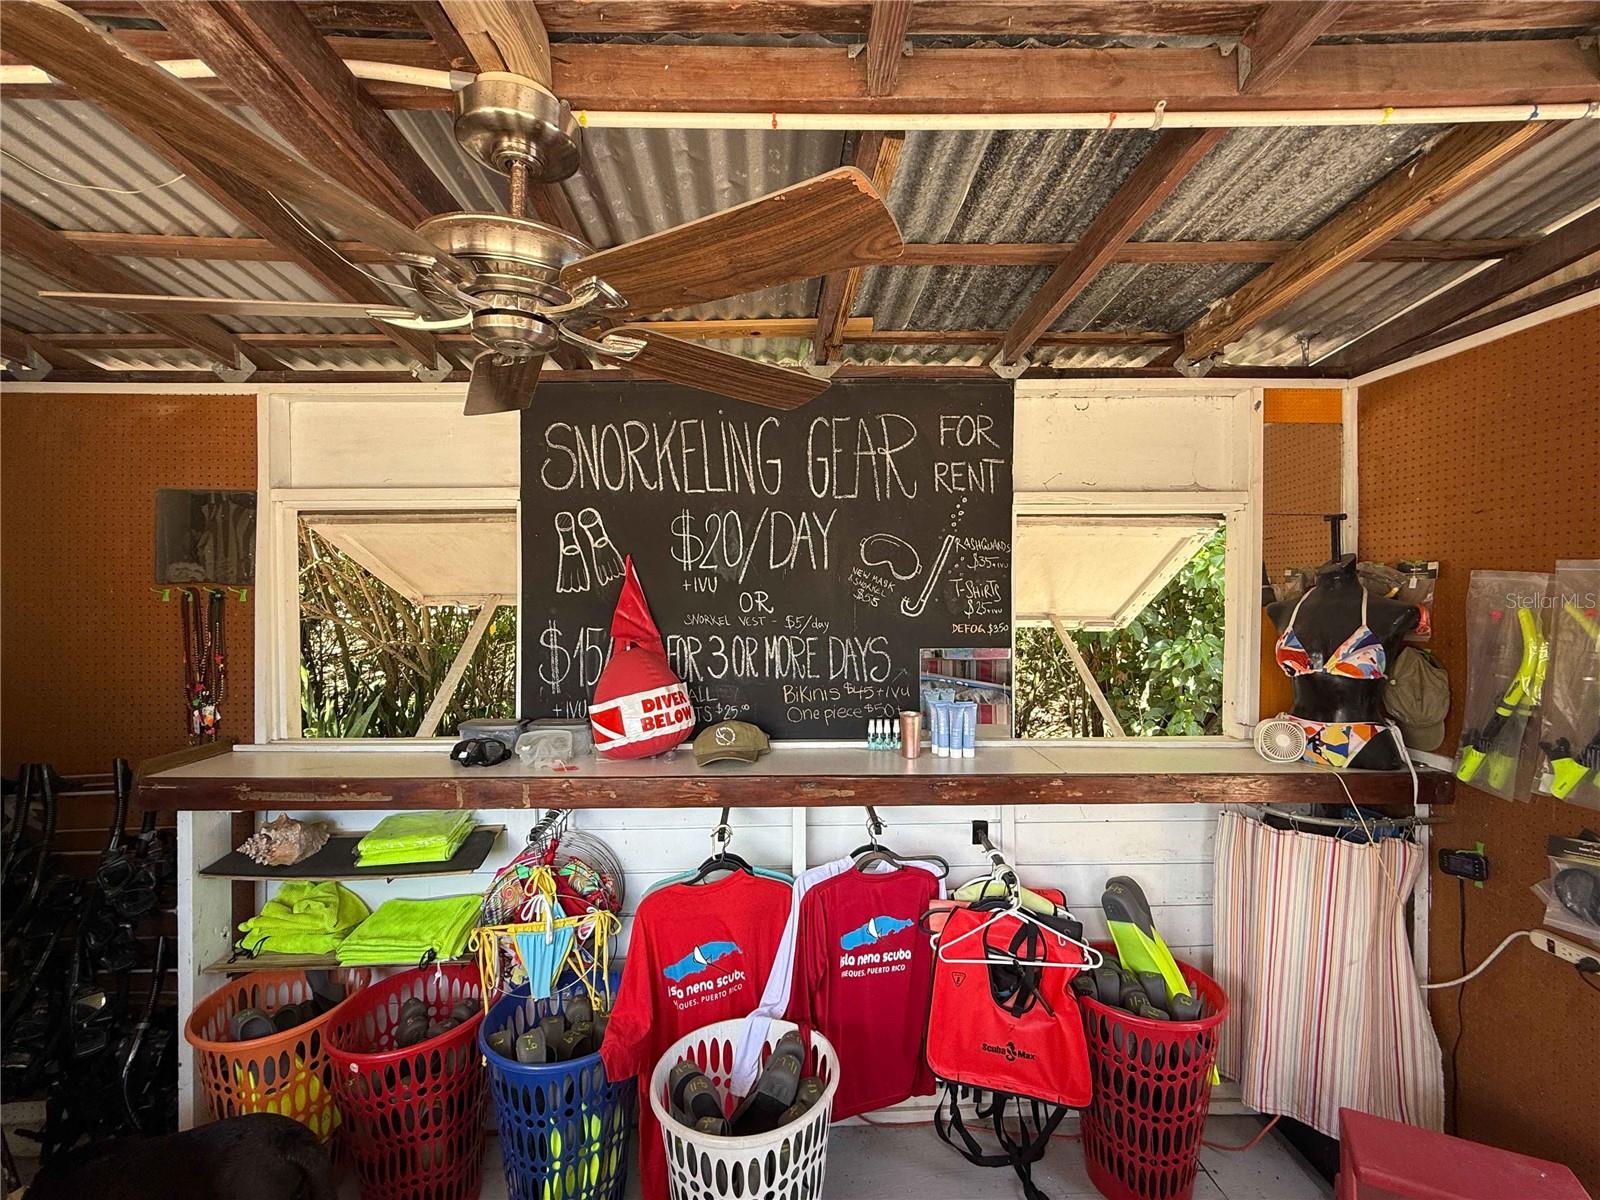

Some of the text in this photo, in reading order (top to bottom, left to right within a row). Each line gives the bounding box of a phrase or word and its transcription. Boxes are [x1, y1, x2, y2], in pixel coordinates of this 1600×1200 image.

[940, 415, 1000, 448] FOR
[808, 414, 917, 501] GEAR
[934, 458, 1005, 494] RENT
[739, 591, 774, 613] OR
[684, 613, 731, 626] SNORKEL
[667, 635, 704, 682] FOR
[707, 635, 729, 679] 3
[732, 635, 758, 678] OR
[764, 635, 820, 679] MORE
[829, 636, 891, 683] DAYS
[641, 691, 687, 714] DIVER
[640, 706, 693, 732] BELOW
[882, 948, 912, 961] scuba
[867, 966, 890, 975] PUERTO
[891, 964, 906, 972] RICO
[686, 980, 714, 996] nena
[701, 990, 727, 1003] PUERTO
[728, 984, 743, 994] RICO
